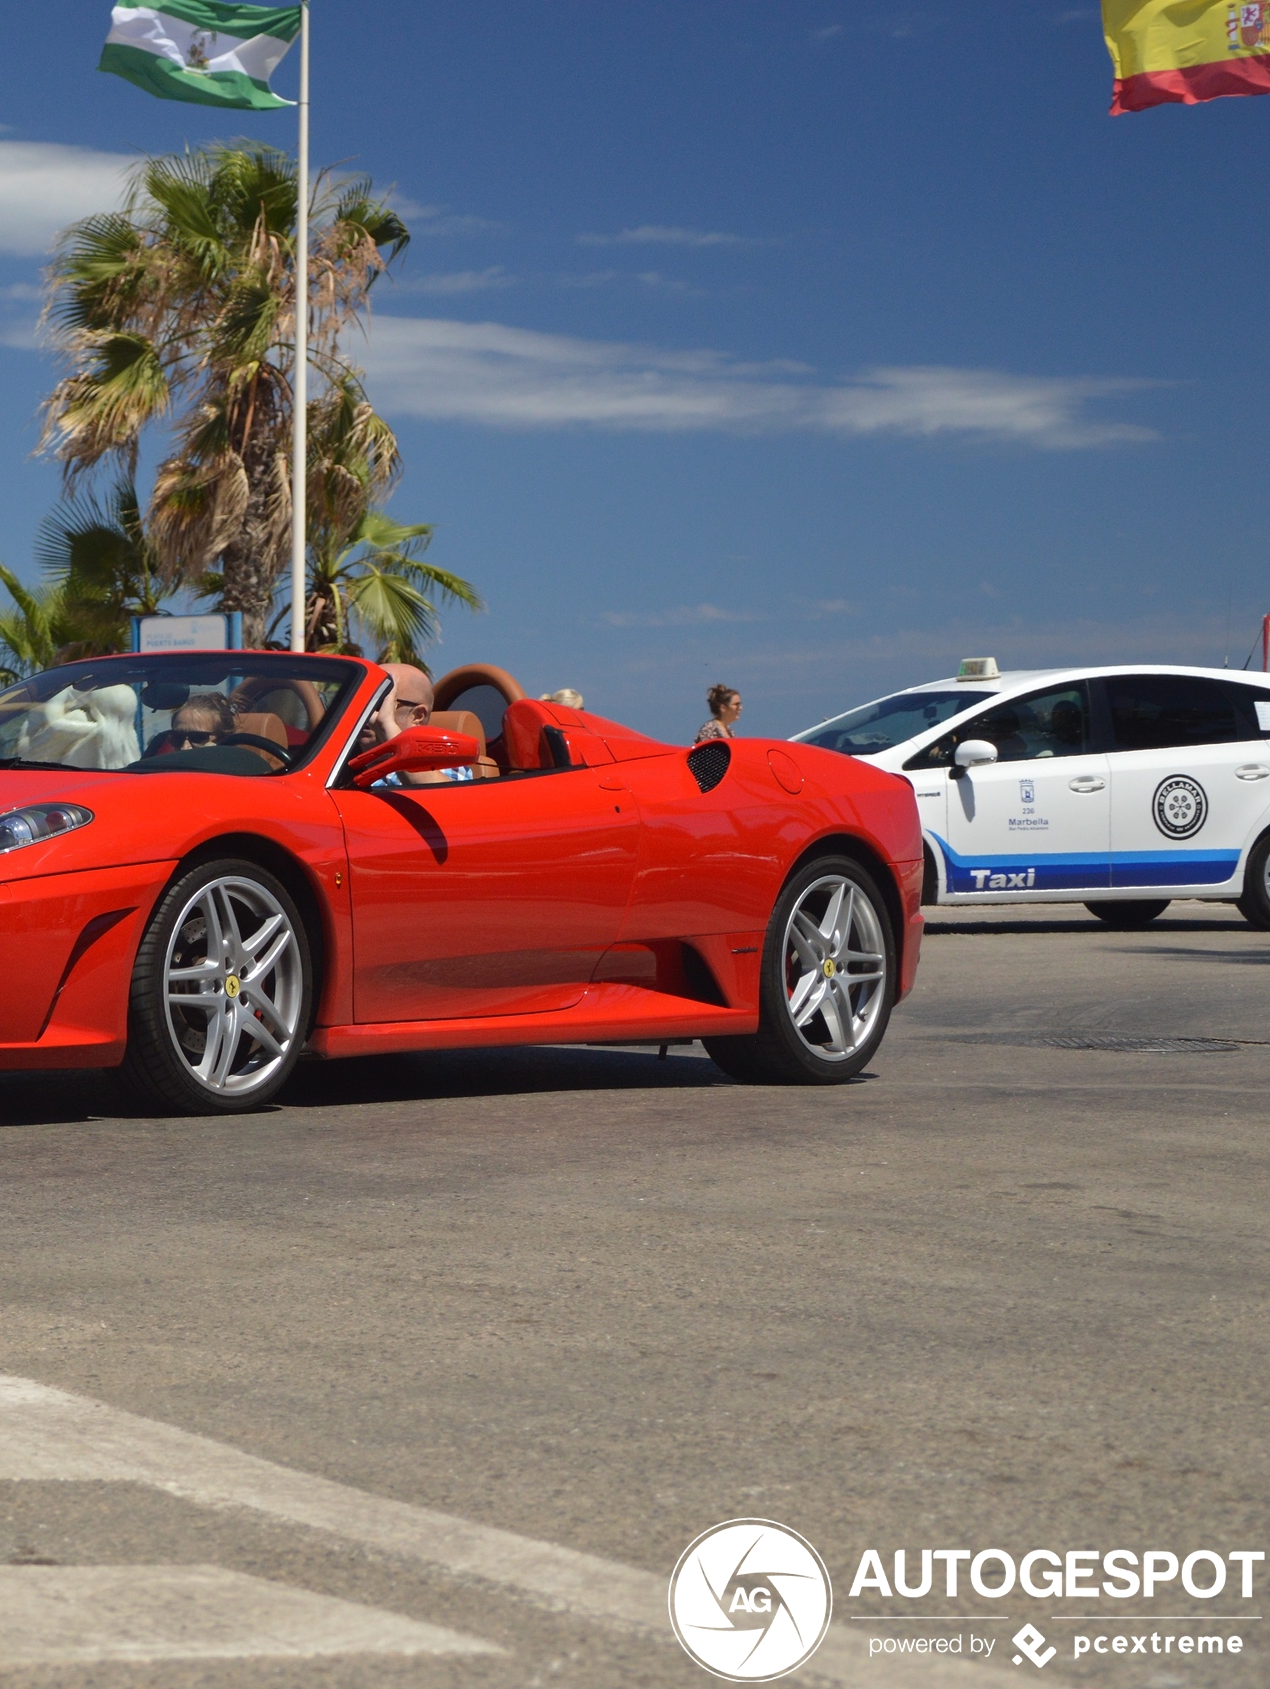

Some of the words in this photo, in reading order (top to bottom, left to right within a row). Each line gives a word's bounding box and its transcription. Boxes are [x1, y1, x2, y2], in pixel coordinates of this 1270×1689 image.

[1159, 782, 1202, 803] BELLAMAR
[1008, 818, 1049, 826] Marbella
[970, 868, 1035, 889] Taxi
